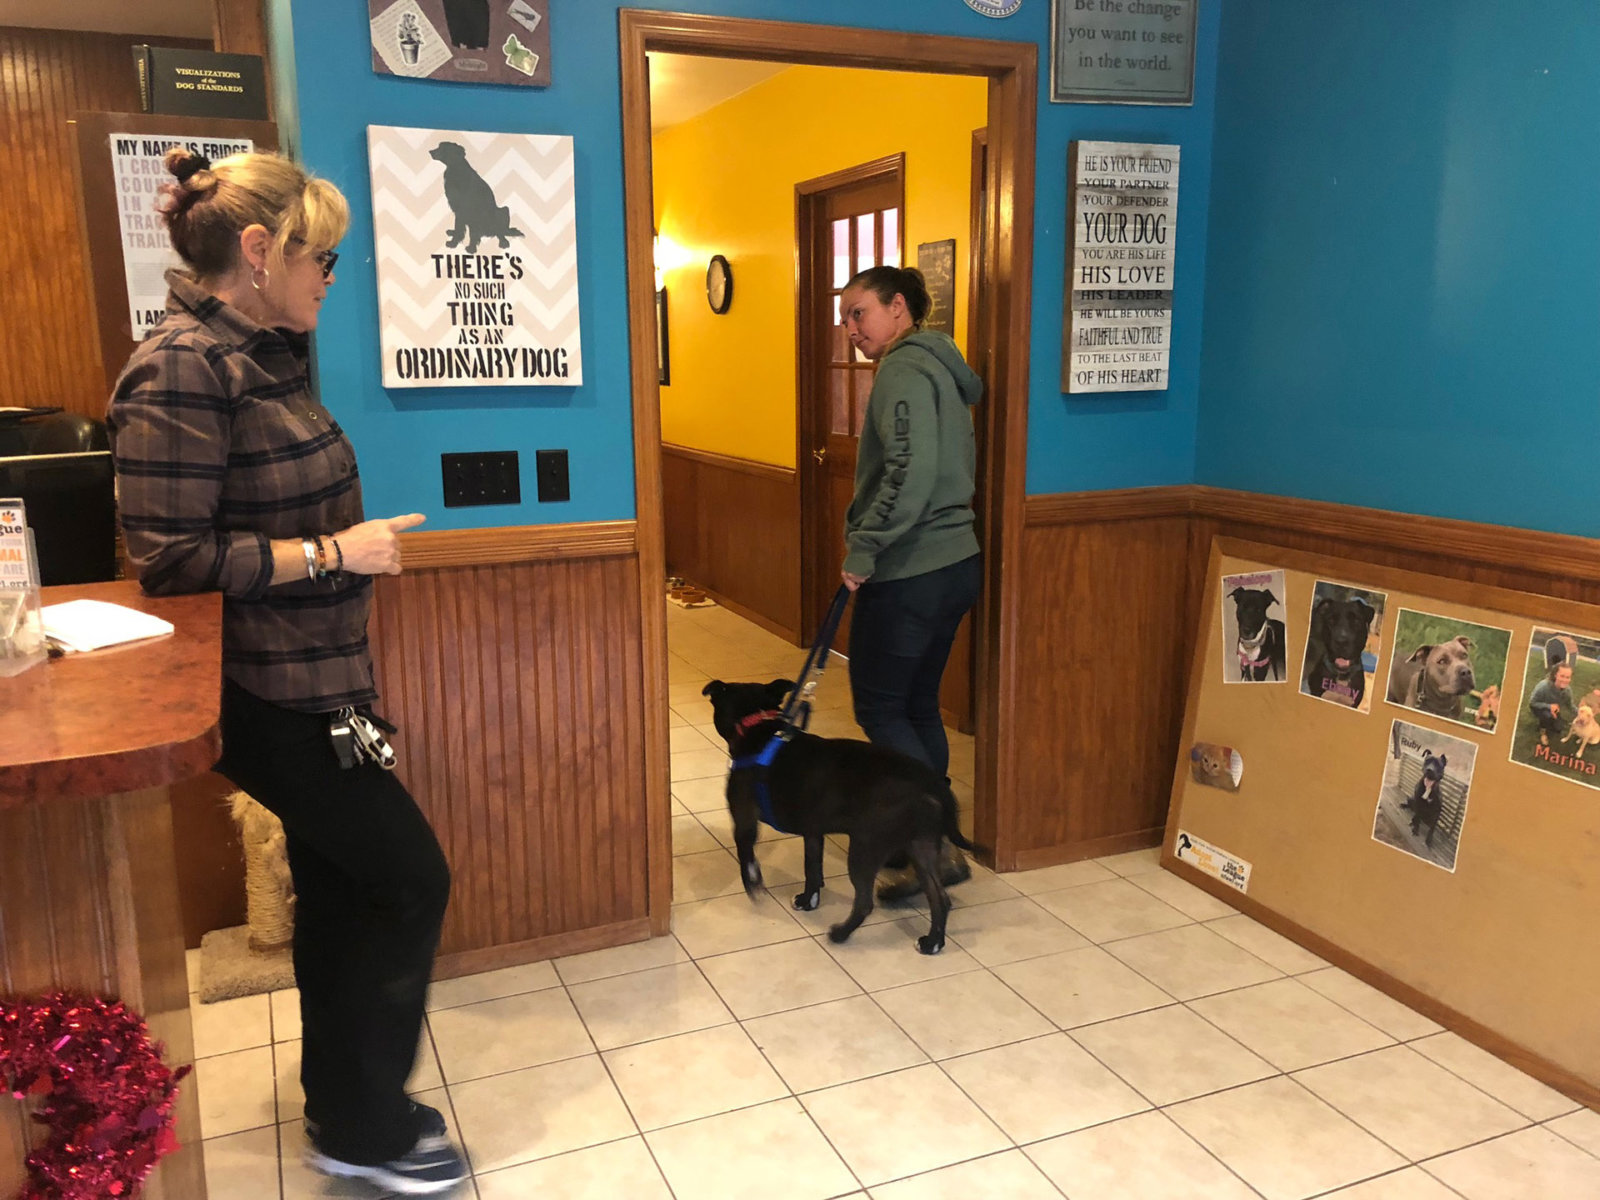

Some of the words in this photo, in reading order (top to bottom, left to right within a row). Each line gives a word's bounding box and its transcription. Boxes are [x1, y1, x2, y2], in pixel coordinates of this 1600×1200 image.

[1074, 0, 1095, 11] Be
[1099, 0, 1122, 13] the
[1127, 0, 1182, 21] change
[1068, 27, 1096, 44] you
[1101, 28, 1137, 42] want
[1142, 29, 1156, 43] to
[1160, 32, 1183, 44] see
[1078, 51, 1093, 68] in
[1098, 52, 1122, 69] the
[1125, 54, 1172, 71] world.
[175, 68, 241, 79] VISUALIZATIONS
[175, 82, 195, 90] DOG
[196, 83, 243, 93] STANDARDS
[117, 140, 138, 155] MY
[142, 140, 181, 157] NAM
[186, 142, 199, 157] IS
[119, 159, 124, 174] I
[1085, 155, 1098, 171] HE
[1100, 156, 1109, 171] IS
[1110, 156, 1136, 173] YOUR
[1138, 158, 1172, 174] FRIEND
[1084, 178, 1116, 189] YOUR
[1120, 179, 1170, 190] PARTNER
[123, 196, 141, 211] IN
[1083, 194, 1113, 206] YOUR
[1116, 195, 1169, 207] DEFENDER
[1083, 212, 1128, 244] YOUR
[1082, 249, 1104, 260] YOU
[1106, 249, 1126, 260] ARE
[1128, 249, 1144, 260] HIS
[1146, 249, 1167, 260] LIFE
[431, 252, 524, 280] THERE'S
[1080, 266, 1111, 284] HIS
[1118, 266, 1166, 284] LOVE
[454, 282, 471, 299] NO
[474, 282, 505, 300] SUCH
[1081, 289, 1104, 300] HIS
[1108, 289, 1163, 300] LEADER
[136, 310, 141, 325] I
[145, 310, 165, 325] AM
[447, 302, 514, 326] THING
[1080, 309, 1093, 319] HE
[1095, 308, 1118, 319] WILL
[1120, 308, 1132, 318] BE
[1134, 308, 1165, 318] YOURS
[458, 329, 479, 345] AS
[484, 329, 504, 345] AN
[1078, 327, 1119, 346] FAITHFUL
[1120, 326, 1140, 345] AND
[1141, 326, 1163, 345] TRUE
[396, 348, 519, 379] ORDINARY
[522, 348, 568, 378] DOG
[1078, 354, 1091, 364] TO
[1092, 353, 1111, 364] THE
[1112, 353, 1137, 363] LAST
[1138, 352, 1163, 362] BEAT
[1077, 370, 1095, 385] OF
[1097, 370, 1118, 384] HIS
[1121, 368, 1162, 384] HEART
[1401, 737, 1422, 752] Ruby
[1534, 743, 1597, 775] Marina
